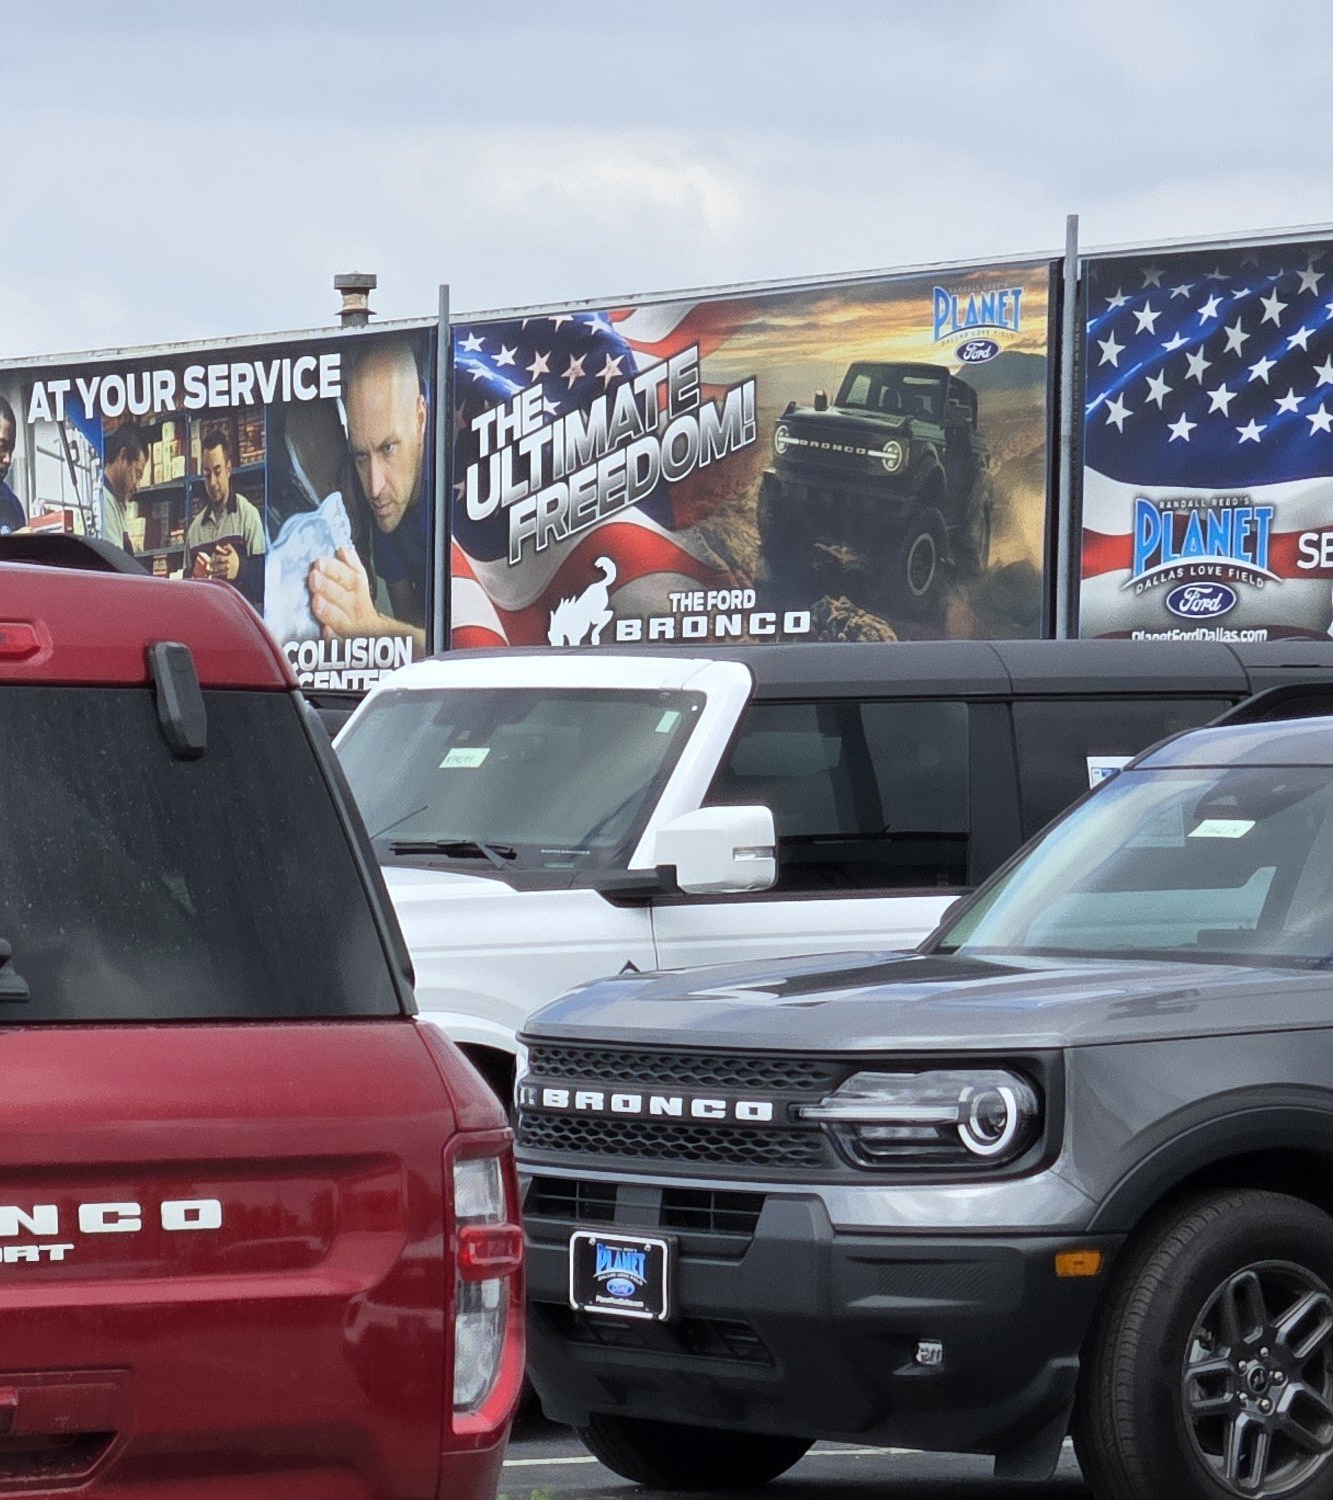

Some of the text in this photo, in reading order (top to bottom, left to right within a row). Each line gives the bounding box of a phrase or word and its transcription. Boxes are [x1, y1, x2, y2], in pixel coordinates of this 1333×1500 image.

[933, 286, 1024, 341] PLANET
[963, 342, 991, 360] Ford
[27, 353, 341, 424] AT YOUR SERVICE
[466, 345, 699, 521] ULTIMATE
[472, 383, 543, 458] THE
[509, 379, 756, 565] FREEDOM!
[1134, 498, 1274, 580] PLANET
[1136, 566, 1264, 594] DALLAS LOVE FIELD
[669, 589, 756, 612] THE FORD
[1179, 587, 1223, 612] Ford
[616, 611, 811, 641] BRONCO
[283, 636, 413, 671] COLLISION
[543, 1088, 773, 1121] BRONCO
[596, 1243, 646, 1280] PLANET
